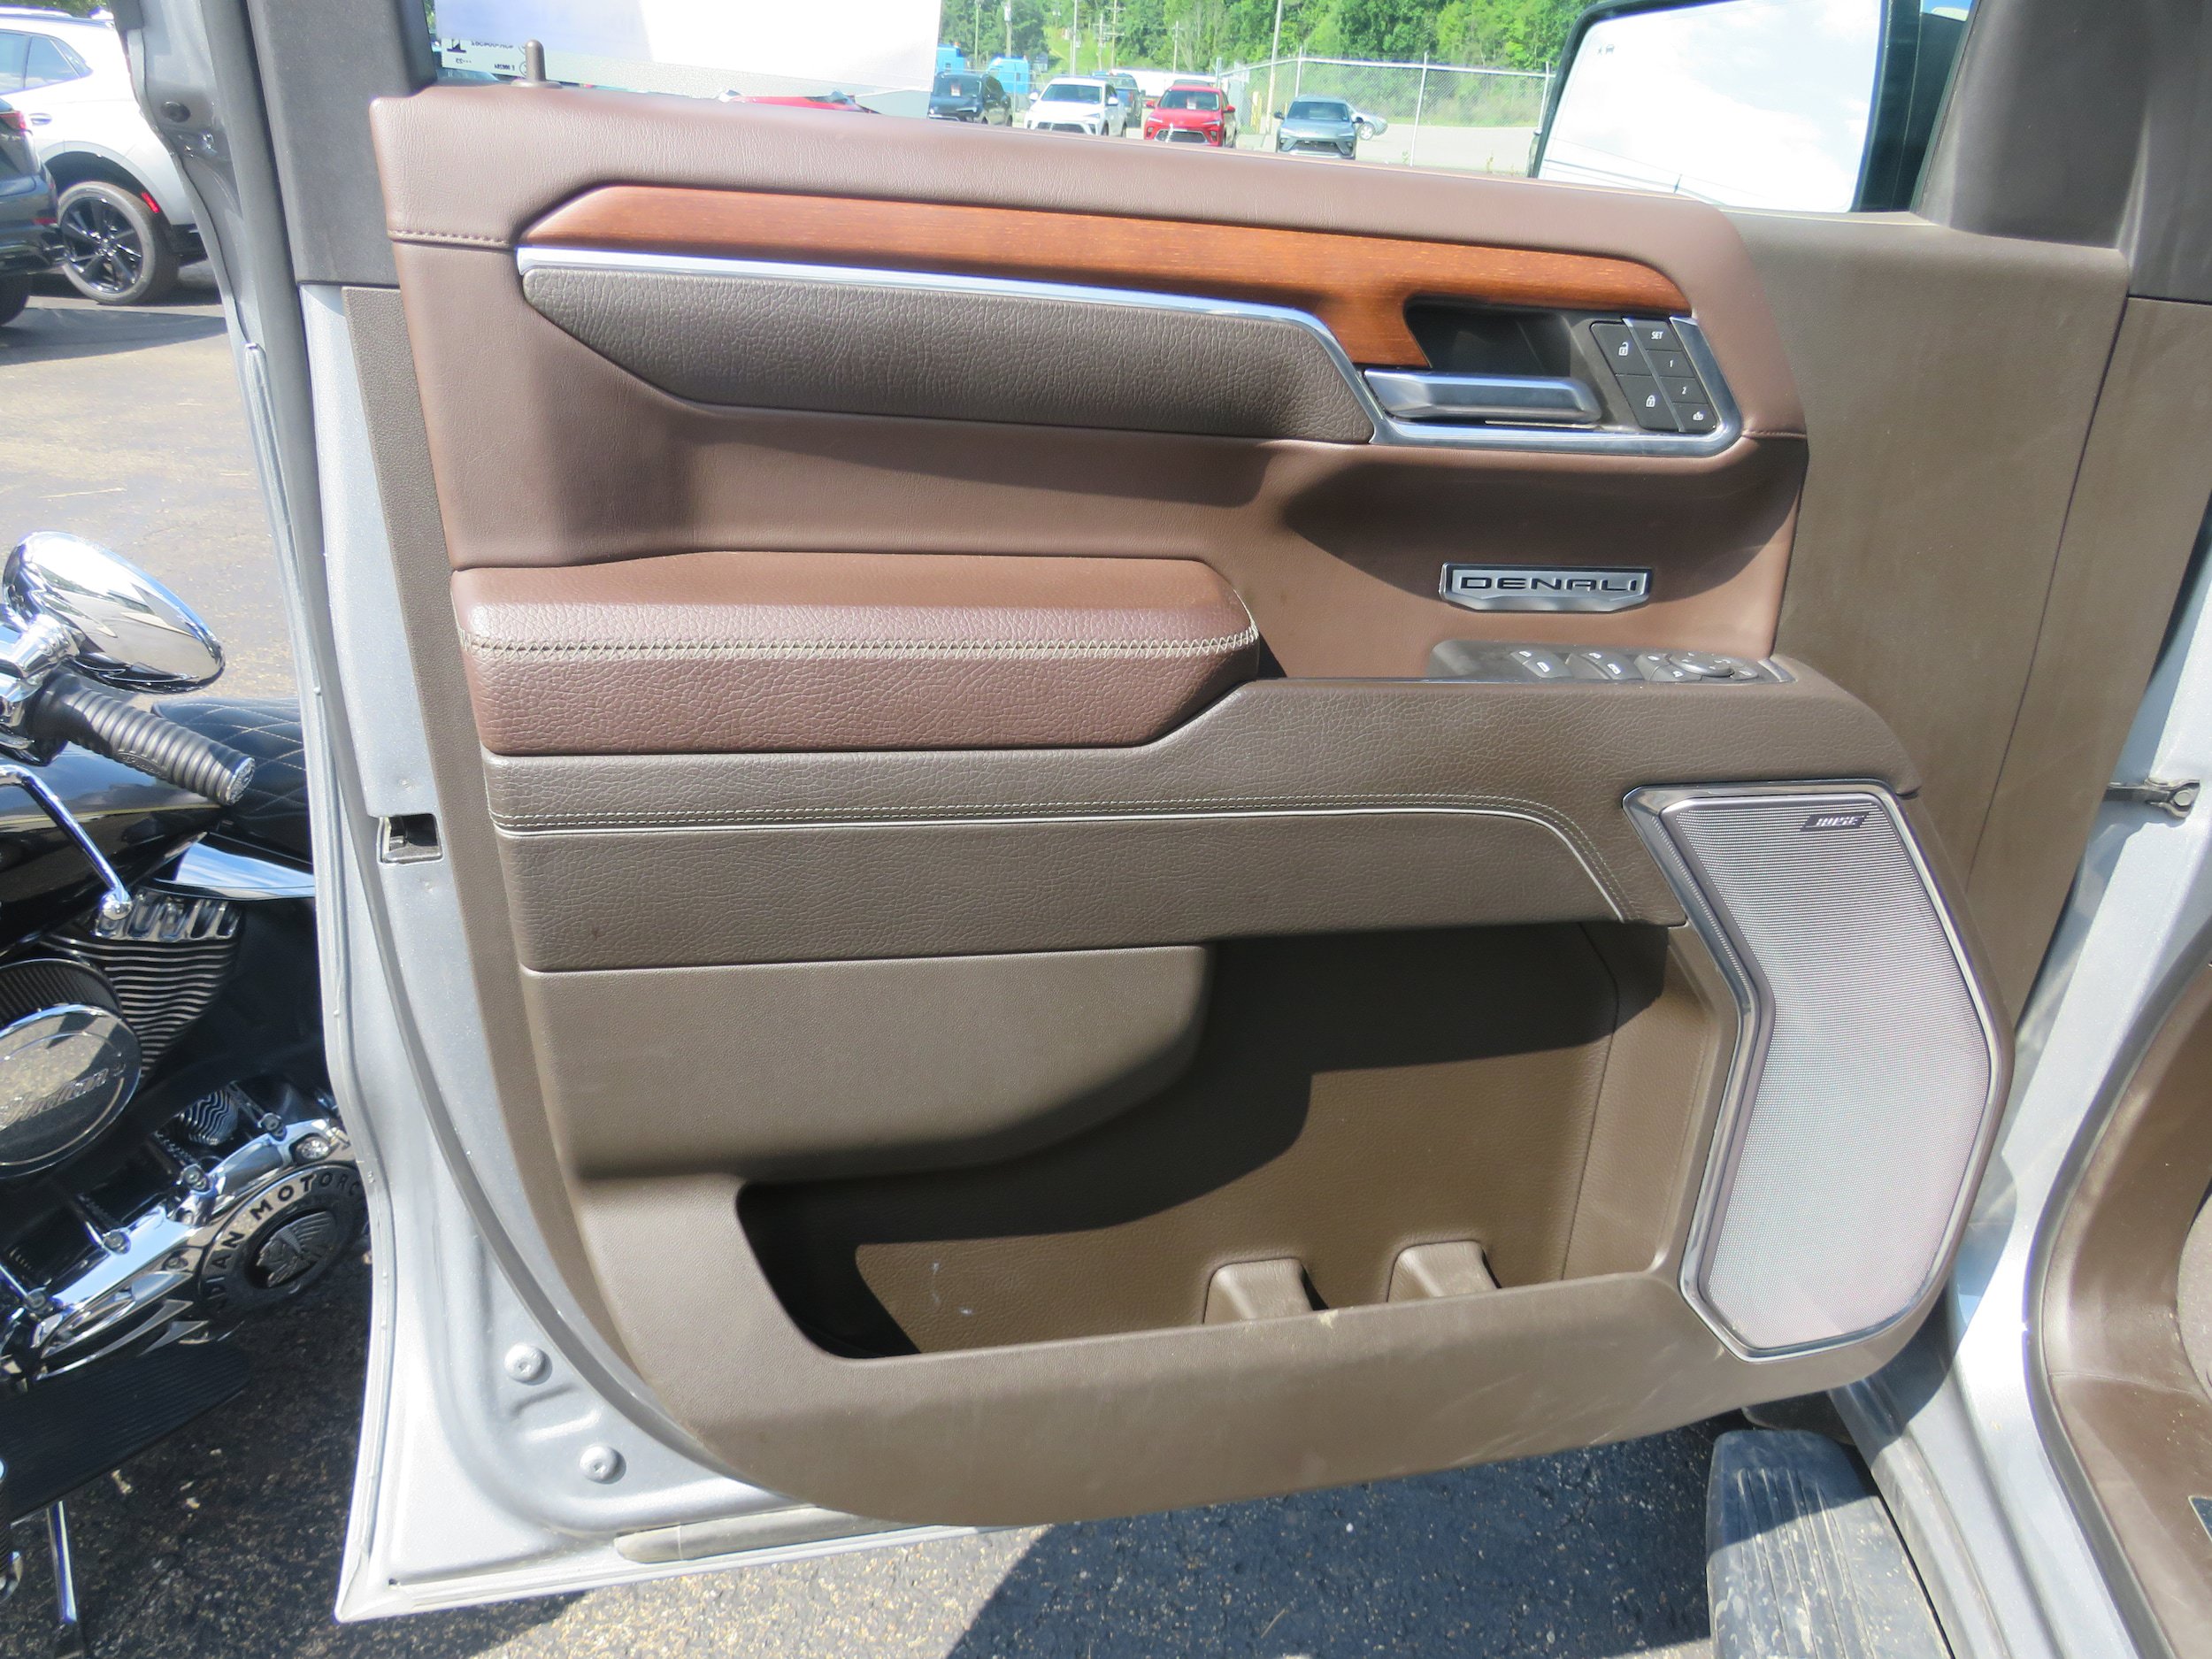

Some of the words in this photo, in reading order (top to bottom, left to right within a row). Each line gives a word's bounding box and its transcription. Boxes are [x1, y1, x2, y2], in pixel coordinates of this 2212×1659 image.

[1651, 331, 1663, 340] SET
[1681, 386, 1687, 395] 2
[1460, 576, 1638, 592] DENALI
[249, 1172, 362, 1221] MOTORC
